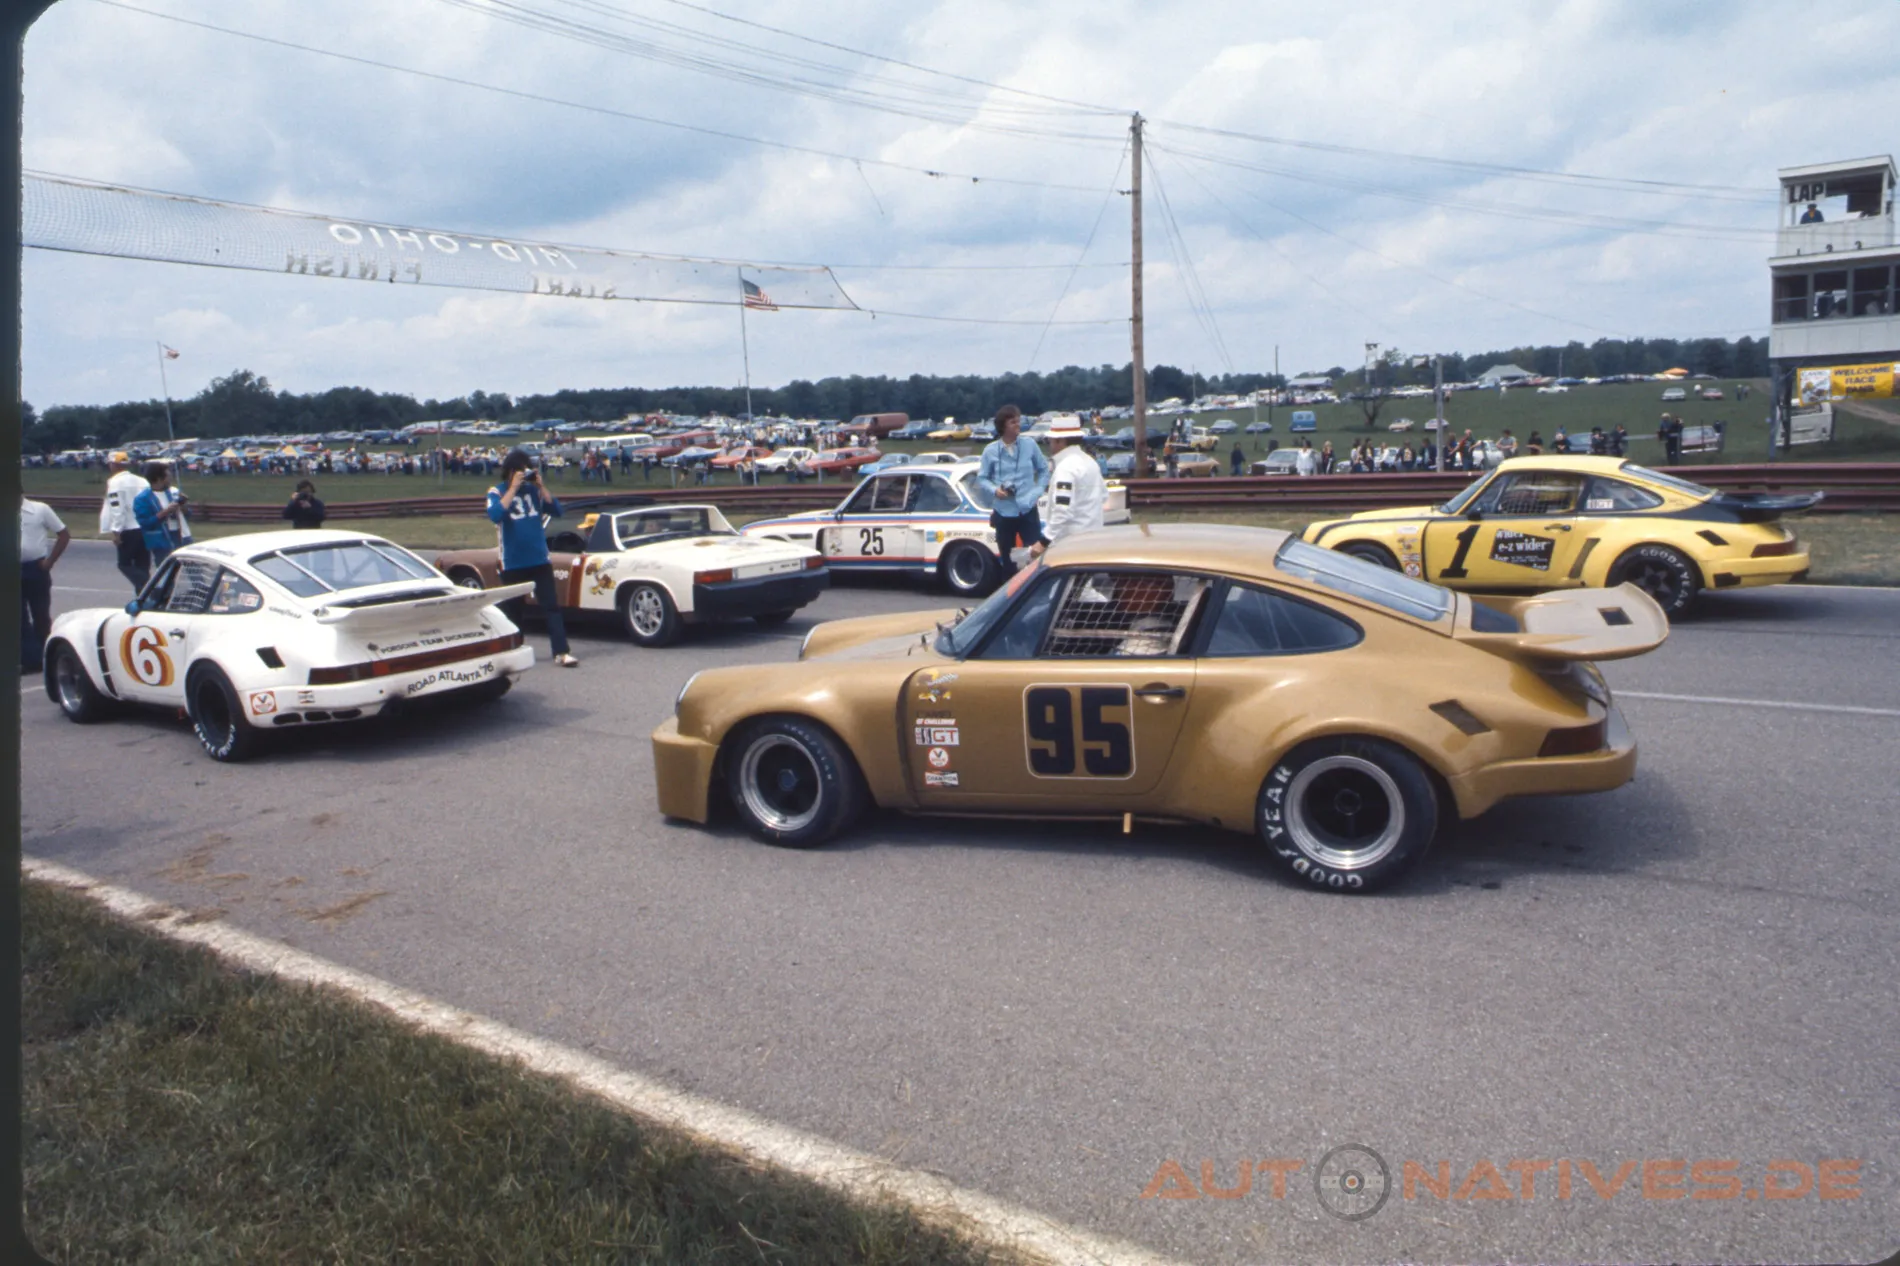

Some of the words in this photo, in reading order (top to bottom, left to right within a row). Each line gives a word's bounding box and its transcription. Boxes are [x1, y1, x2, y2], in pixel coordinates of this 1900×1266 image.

[510, 494, 538, 520] 31
[860, 528, 884, 555] 25
[1440, 524, 1481, 578] 1
[1498, 543, 1514, 552] e-z
[1515, 538, 1547, 551] wider
[121, 626, 174, 687] 6
[381, 642, 419, 654] PORSCHE
[420, 637, 444, 647] TEAM
[407, 675, 436, 694] ROAD
[438, 670, 482, 683] ATLANTA
[933, 729, 957, 742] GT
[1027, 687, 1131, 775] 95
[1265, 766, 1364, 888] GOODYEAR
